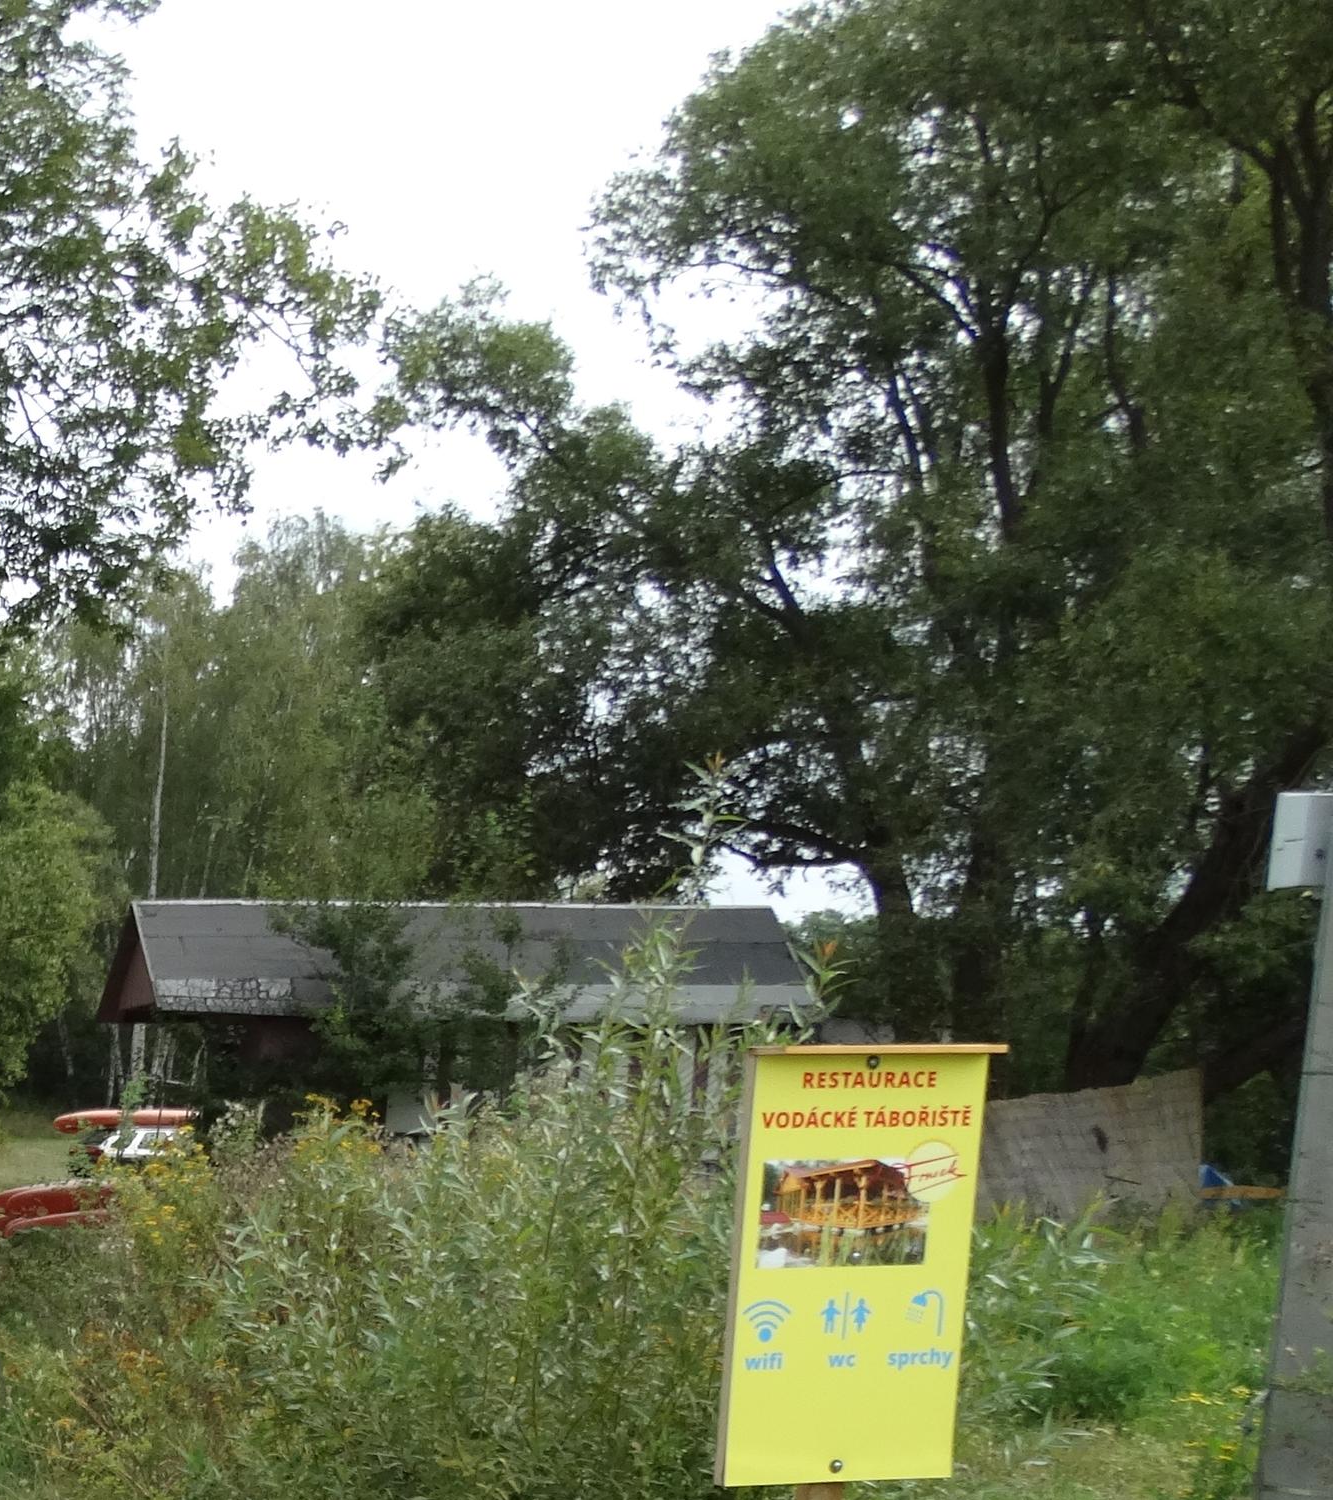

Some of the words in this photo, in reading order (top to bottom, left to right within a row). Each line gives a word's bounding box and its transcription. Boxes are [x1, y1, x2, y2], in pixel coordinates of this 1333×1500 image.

[802, 1071, 938, 1089] RESTAURACE
[762, 1105, 858, 1129] VODÁCKÉ
[863, 1104, 973, 1128] TÁBOŘIŠTĚ
[744, 1352, 784, 1371] wifi
[828, 1354, 856, 1368] wc
[887, 1348, 953, 1371] sprchy
